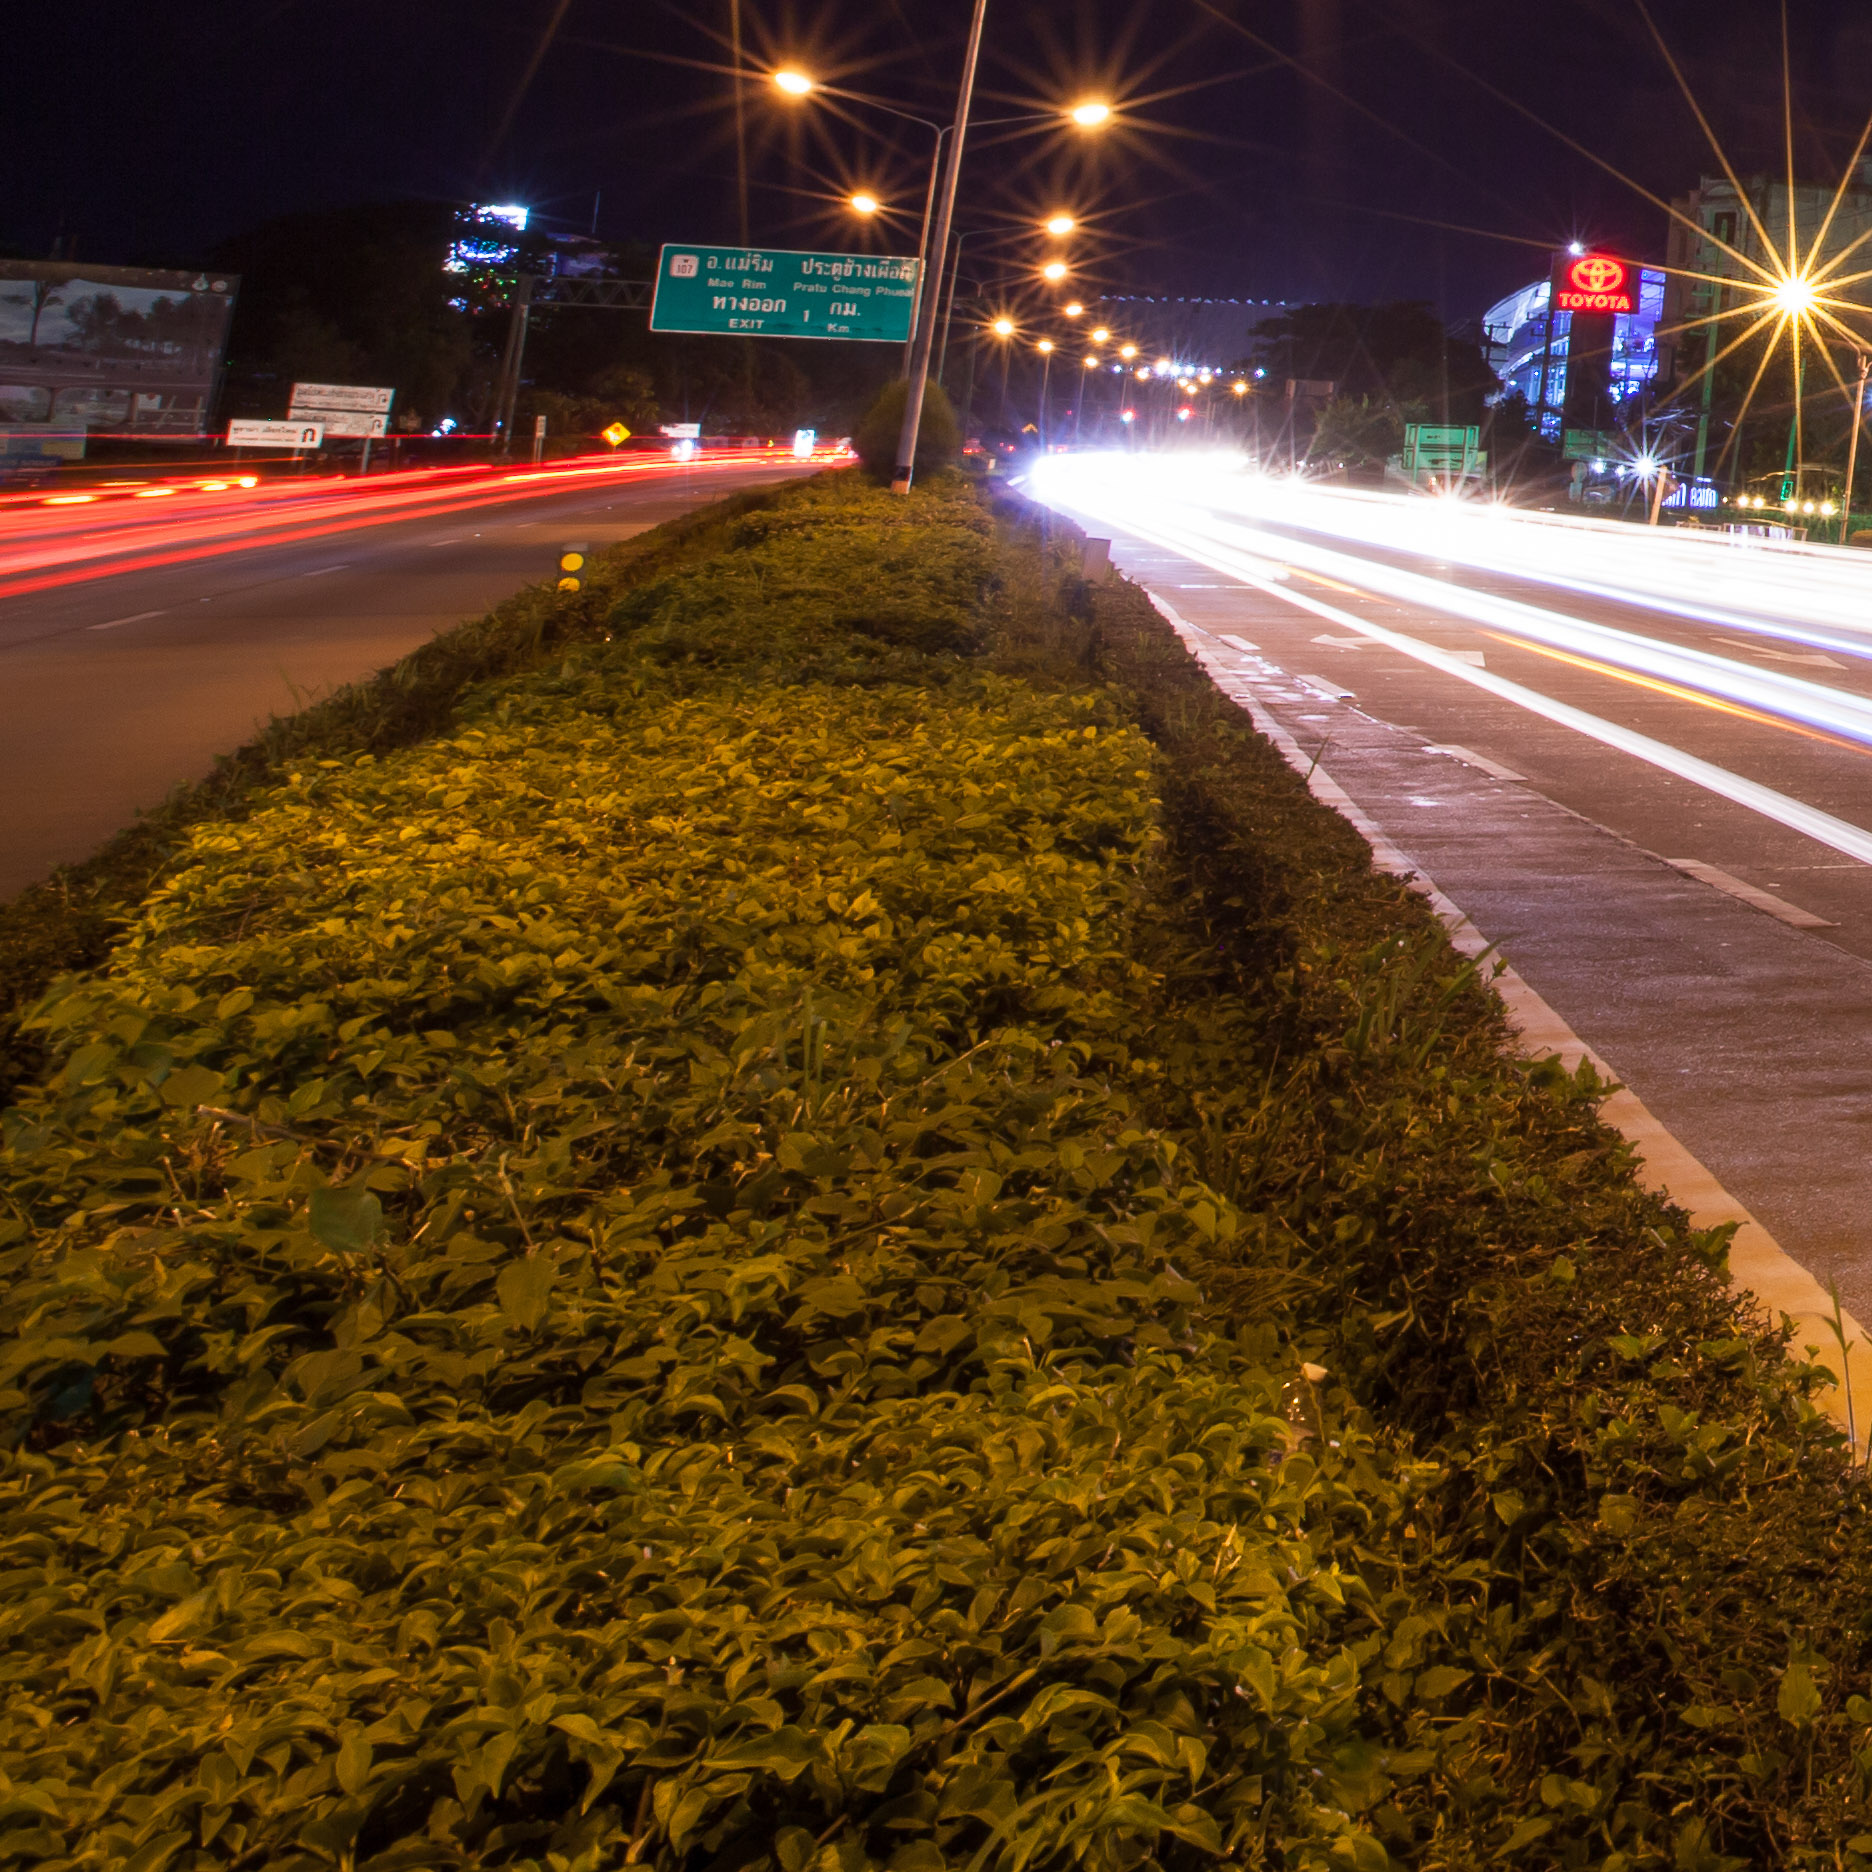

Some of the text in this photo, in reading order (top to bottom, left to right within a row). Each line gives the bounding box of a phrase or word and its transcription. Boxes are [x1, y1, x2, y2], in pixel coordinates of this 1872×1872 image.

[676, 263, 693, 276] 107
[707, 277, 767, 290] Mae Rim
[793, 281, 828, 294] Pratu
[831, 283, 872, 298] Chang
[712, 294, 787, 314] ทางออก
[1559, 293, 1631, 310] TOYOTA
[803, 309, 810, 323] 1
[728, 318, 765, 330] EXIT
